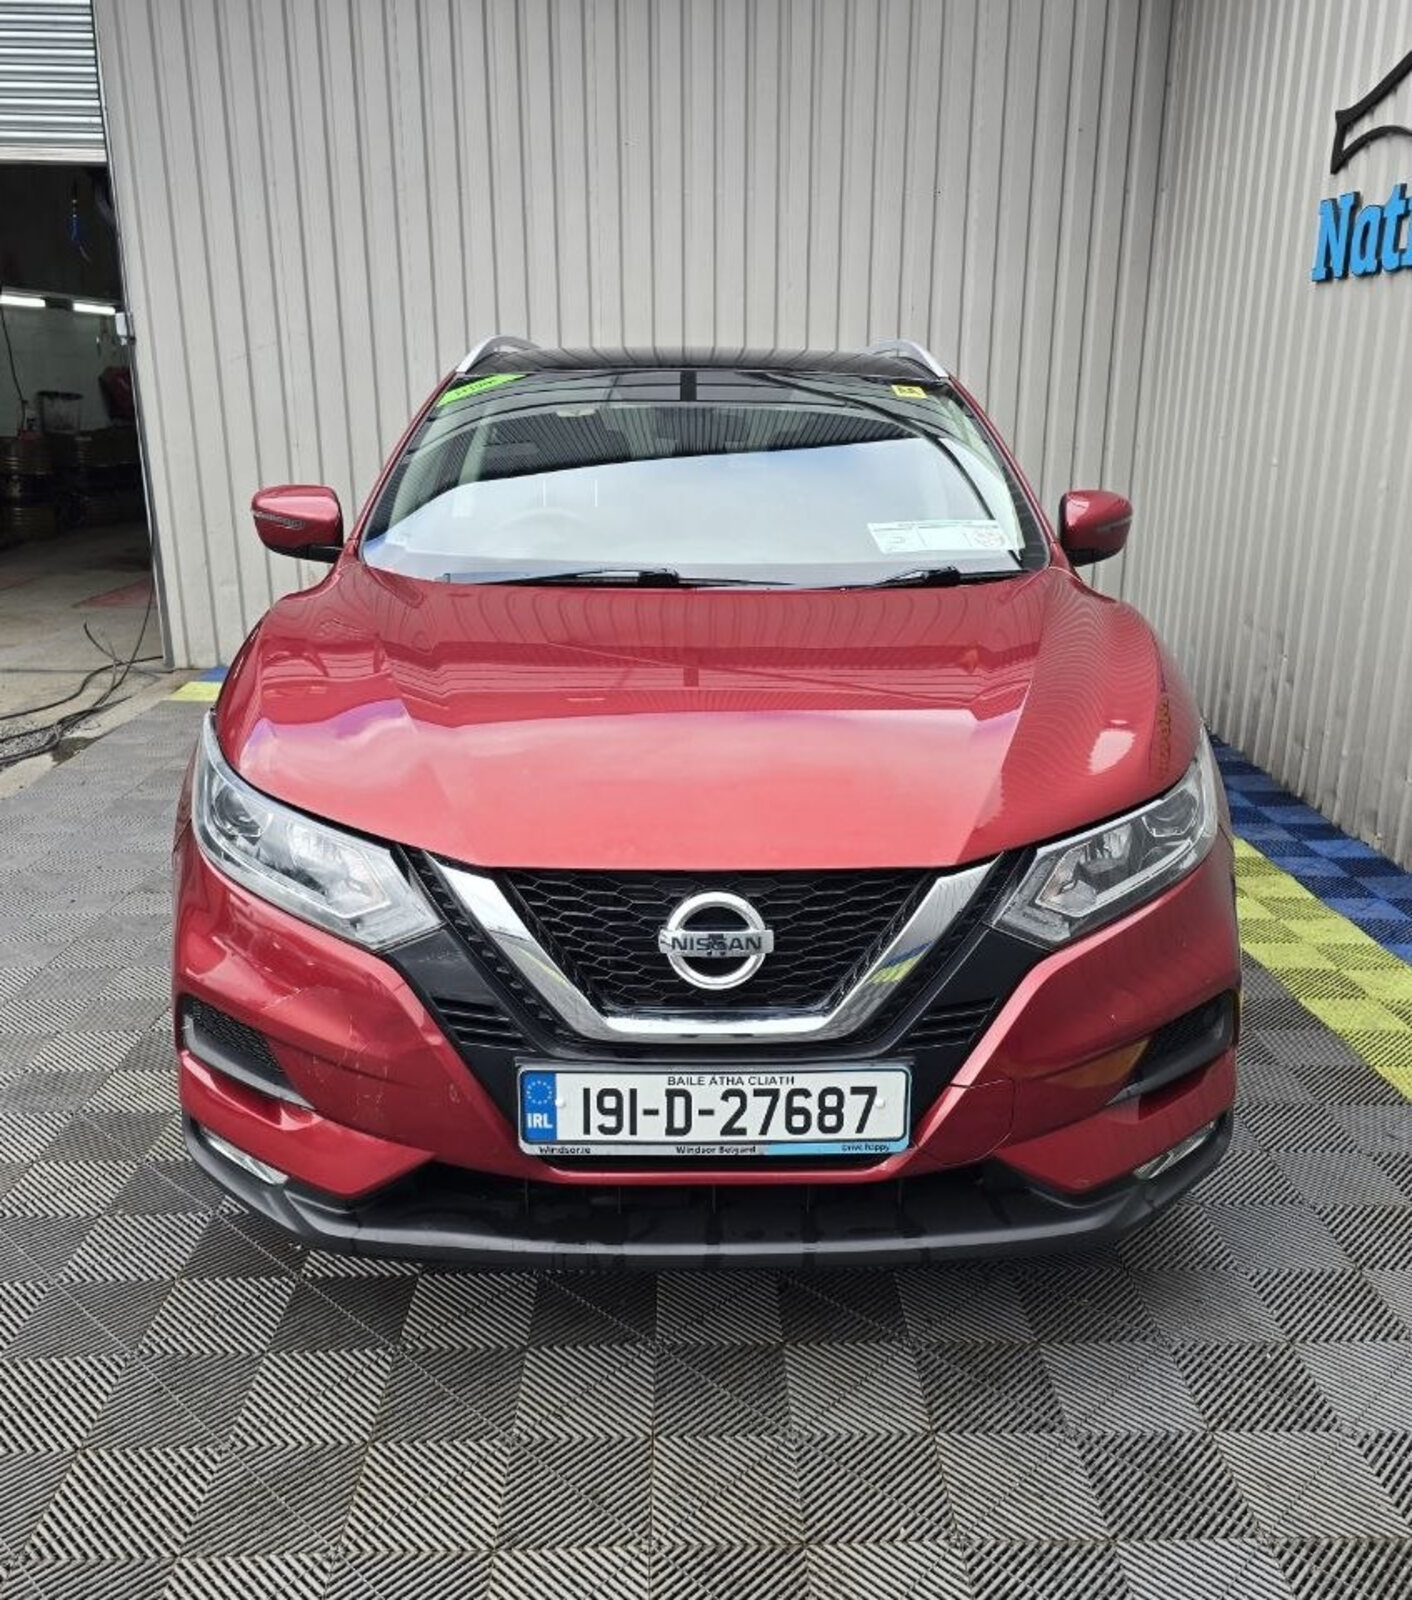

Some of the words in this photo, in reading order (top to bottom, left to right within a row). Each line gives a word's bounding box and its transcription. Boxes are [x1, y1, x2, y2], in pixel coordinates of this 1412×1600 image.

[671, 936, 763, 951] NISSAN
[667, 1075, 706, 1086] BAILE
[747, 1075, 795, 1086] CLIATH
[582, 1087, 878, 1136] 191-D-27687
[527, 1112, 553, 1129] IRL
[676, 1145, 716, 1154] Windsor
